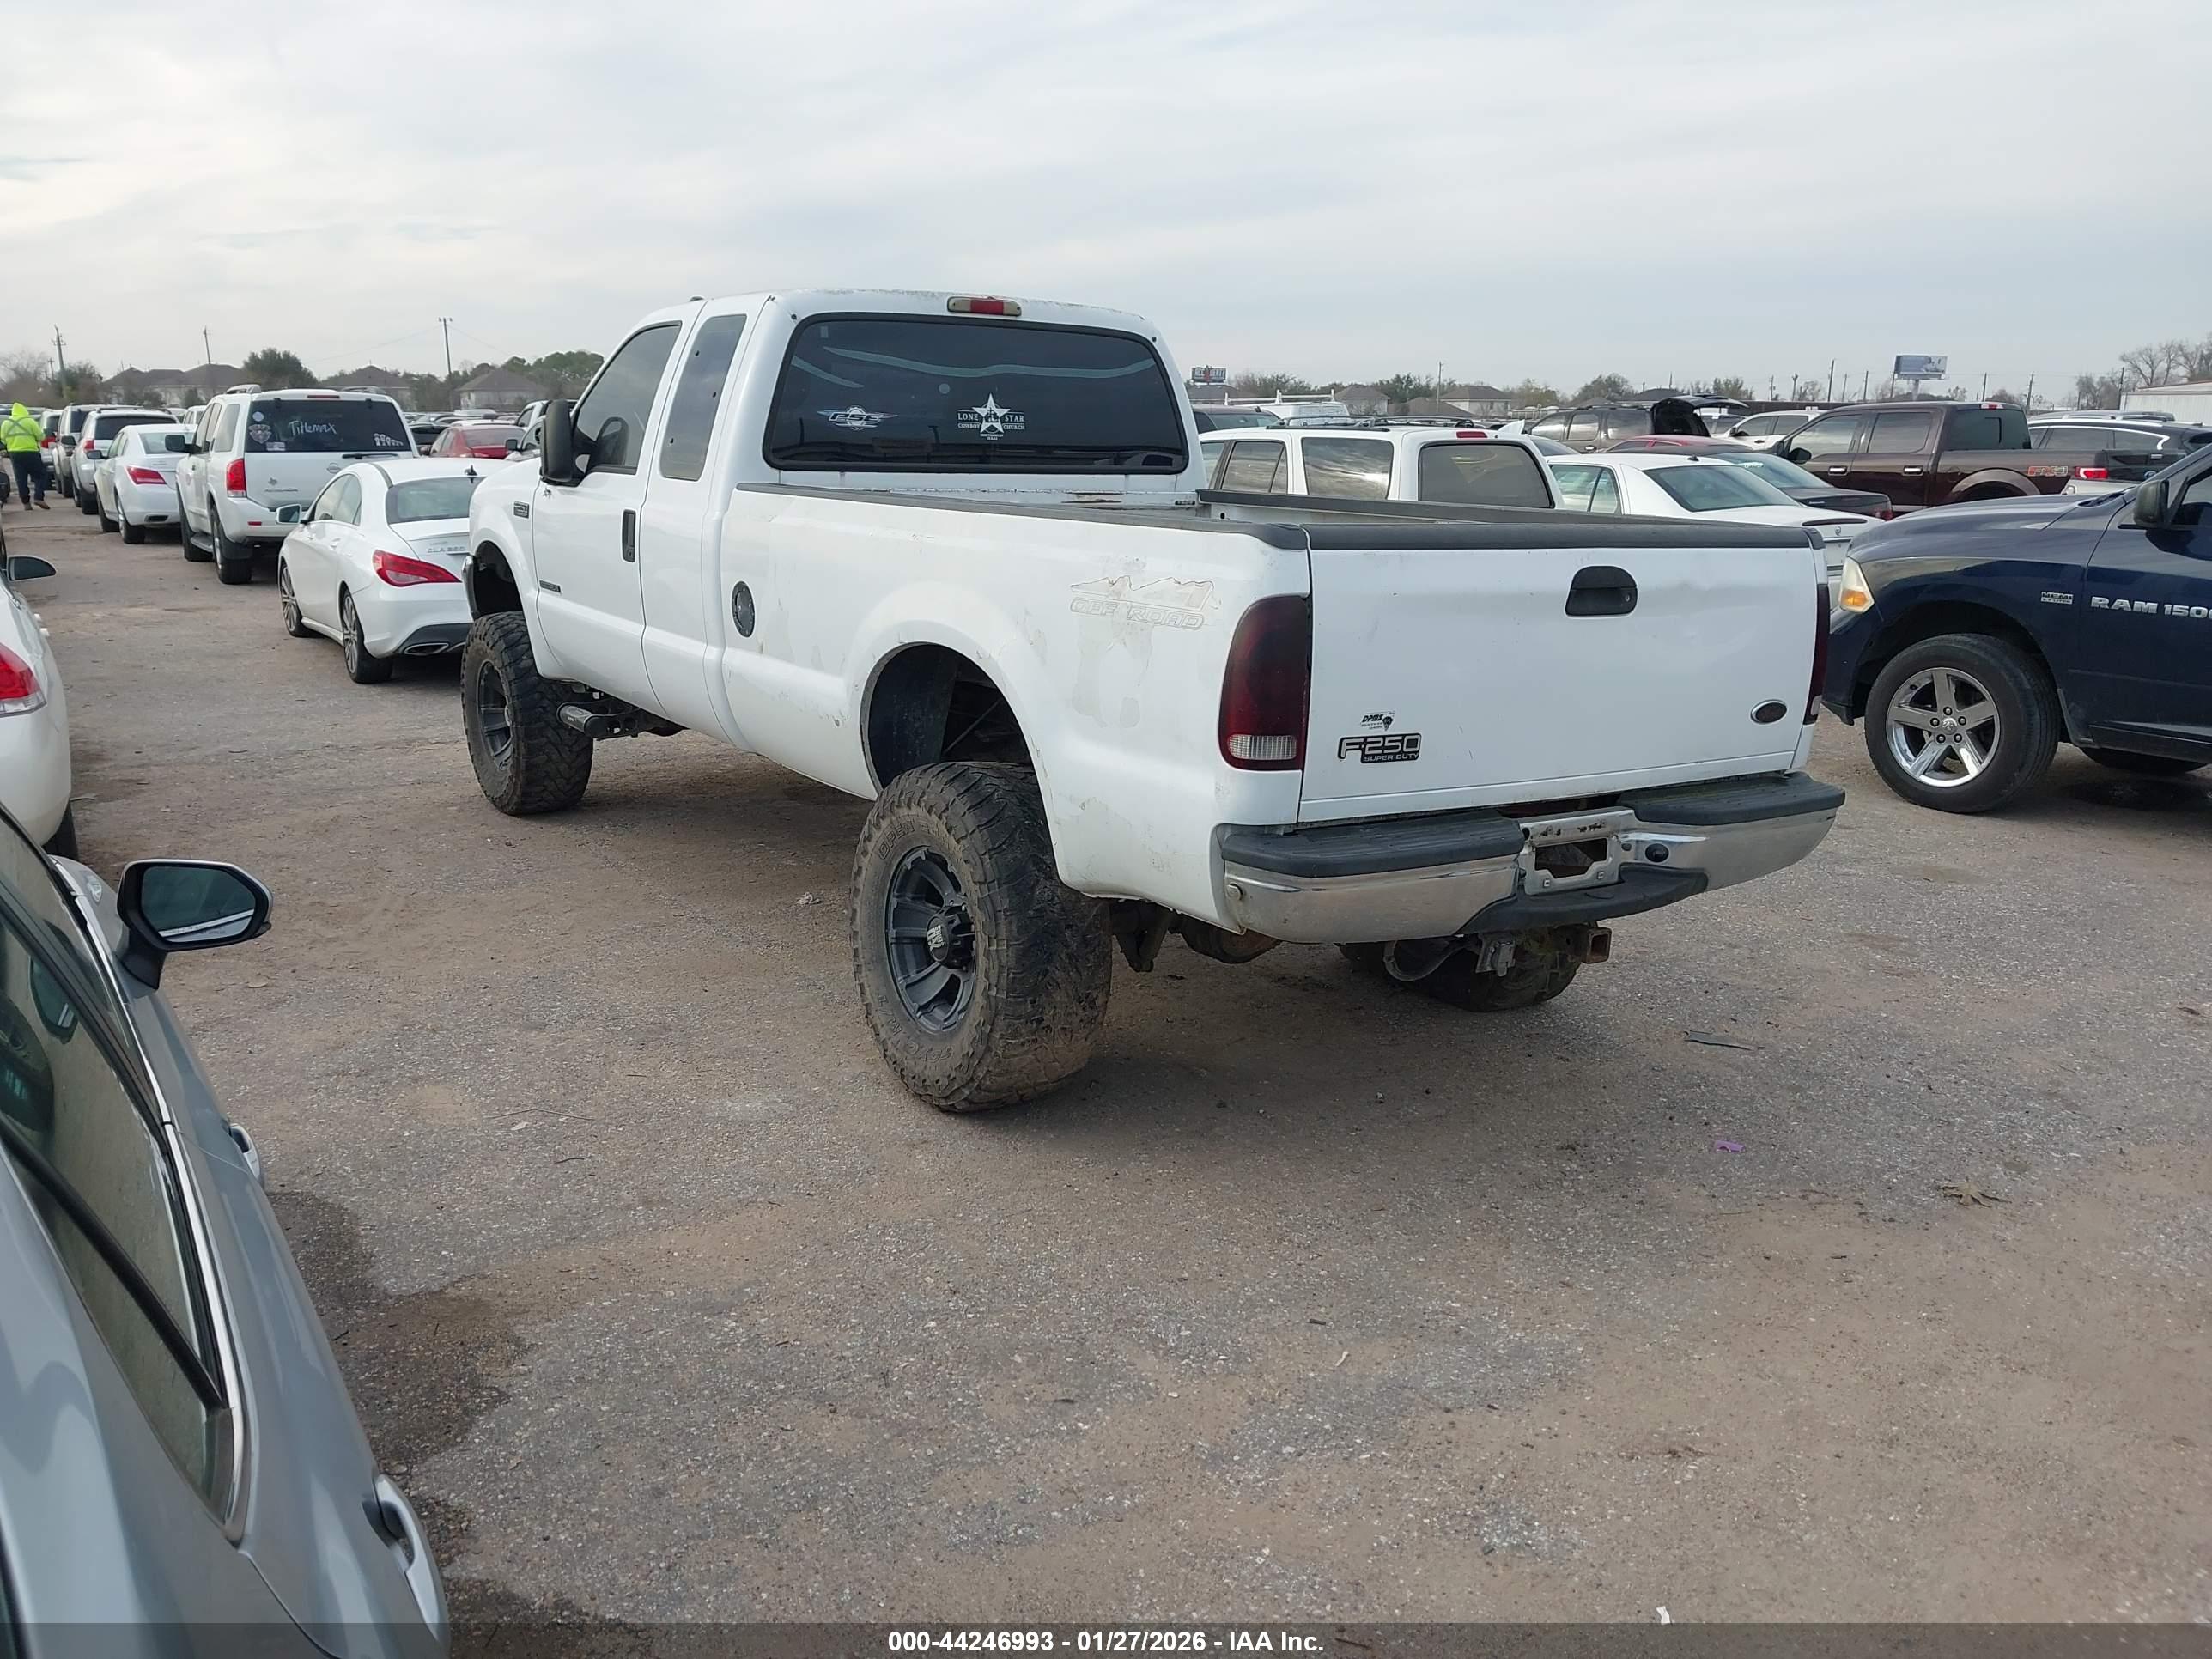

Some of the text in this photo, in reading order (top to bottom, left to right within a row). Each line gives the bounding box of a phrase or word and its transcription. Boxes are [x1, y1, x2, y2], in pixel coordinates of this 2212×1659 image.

[2027, 466, 2069, 477] FX4
[1070, 598, 1205, 630] OFF ROAD
[2091, 596, 2212, 619] RAM 150
[1362, 714, 1384, 723] DPMS
